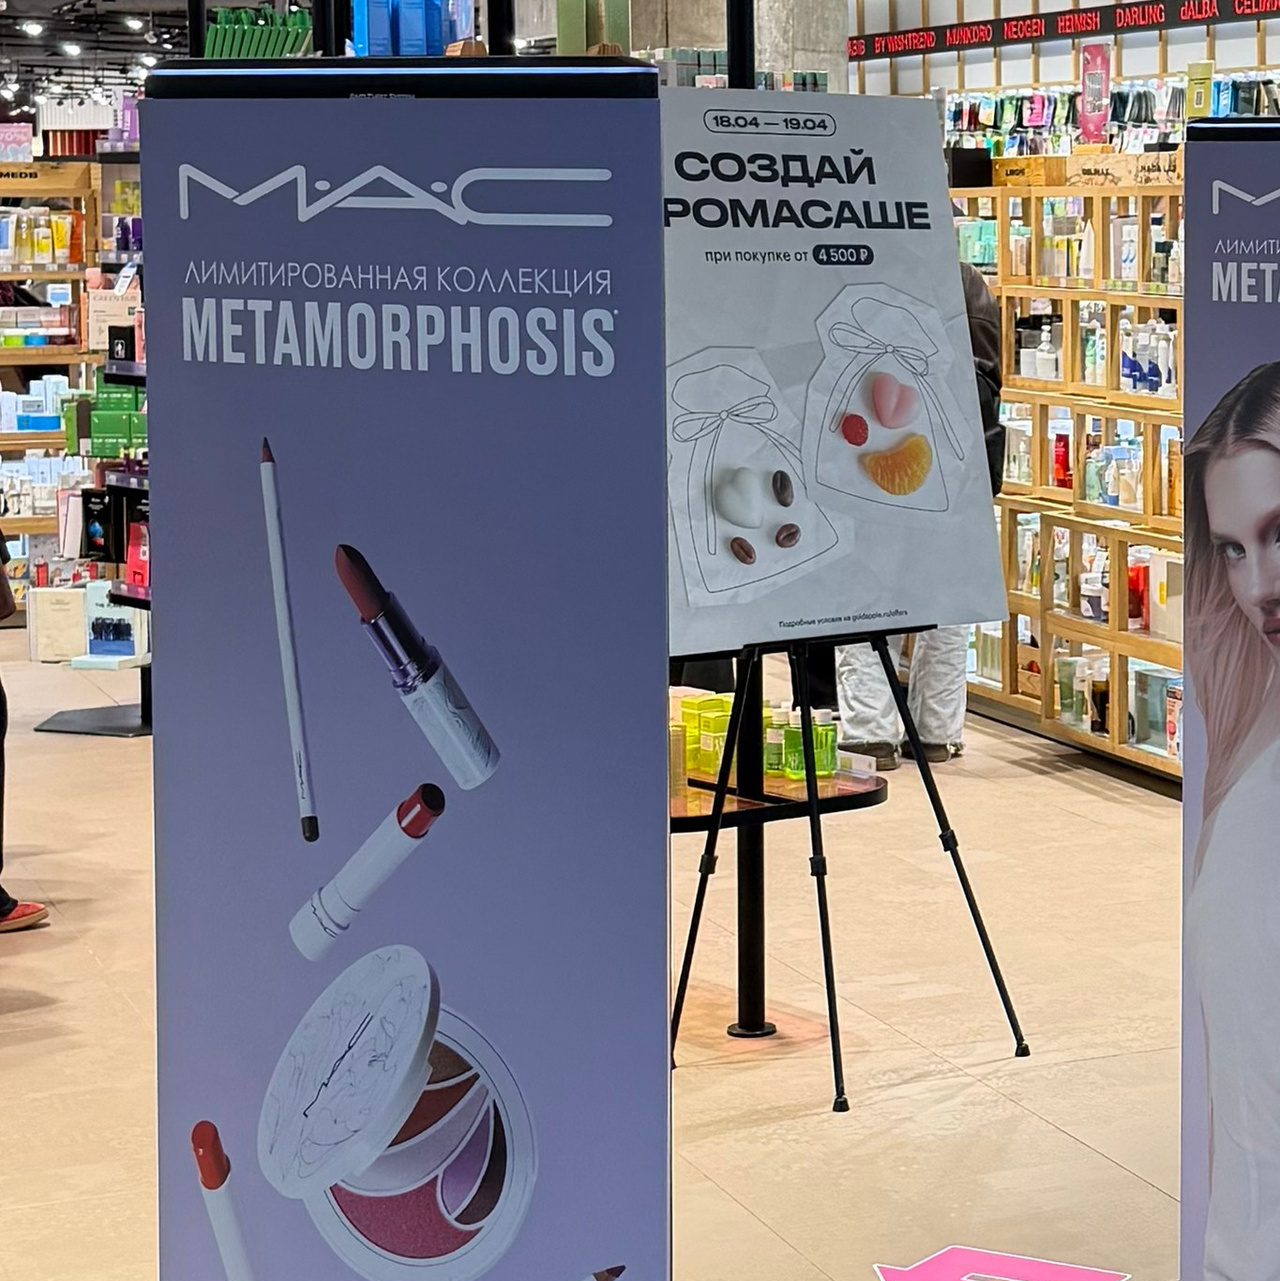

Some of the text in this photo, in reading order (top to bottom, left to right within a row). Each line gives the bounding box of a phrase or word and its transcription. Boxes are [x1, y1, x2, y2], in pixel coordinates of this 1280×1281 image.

[873, 37, 886, 53] BY
[1004, 19, 1045, 40] NEOGEN
[1115, 4, 1165, 28] DARLING
[713, 115, 760, 129] 18.04
[782, 117, 828, 131] 19.04
[674, 148, 876, 188] СОЗДАЙ
[663, 197, 932, 231] РОМАСАШЕ
[705, 251, 732, 265] при
[735, 250, 791, 265] покупке
[794, 251, 809, 263] от
[184, 260, 611, 297] ЛИМИТИРОВАННАЯ КОЛЛЕКЦИЯ
[181, 297, 617, 377] METAMORPHOSIS
